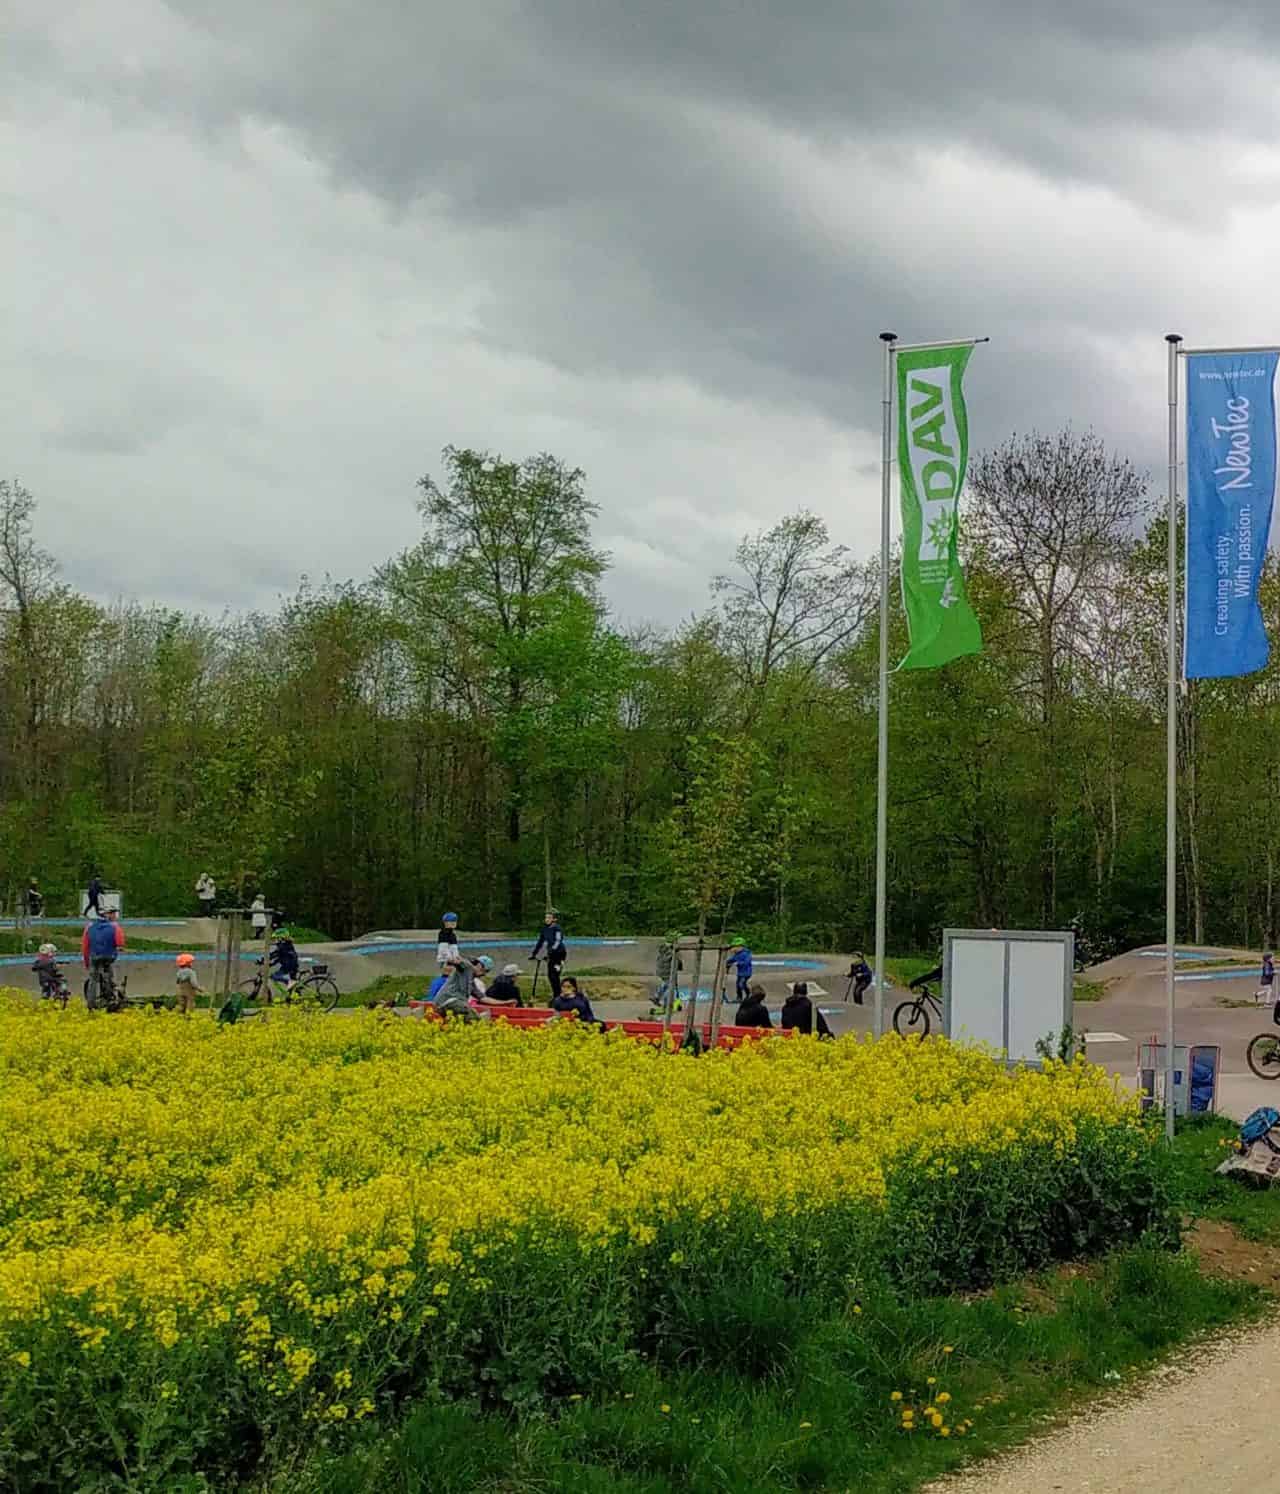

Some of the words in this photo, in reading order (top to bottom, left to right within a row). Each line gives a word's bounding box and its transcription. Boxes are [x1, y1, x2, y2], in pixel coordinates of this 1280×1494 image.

[910, 378, 958, 501] DAV
[1210, 395, 1254, 491] NewTec
[1215, 531, 1234, 575] safety.
[1235, 503, 1255, 562] passion.
[1214, 577, 1233, 636] Creating
[1233, 563, 1251, 599] With
